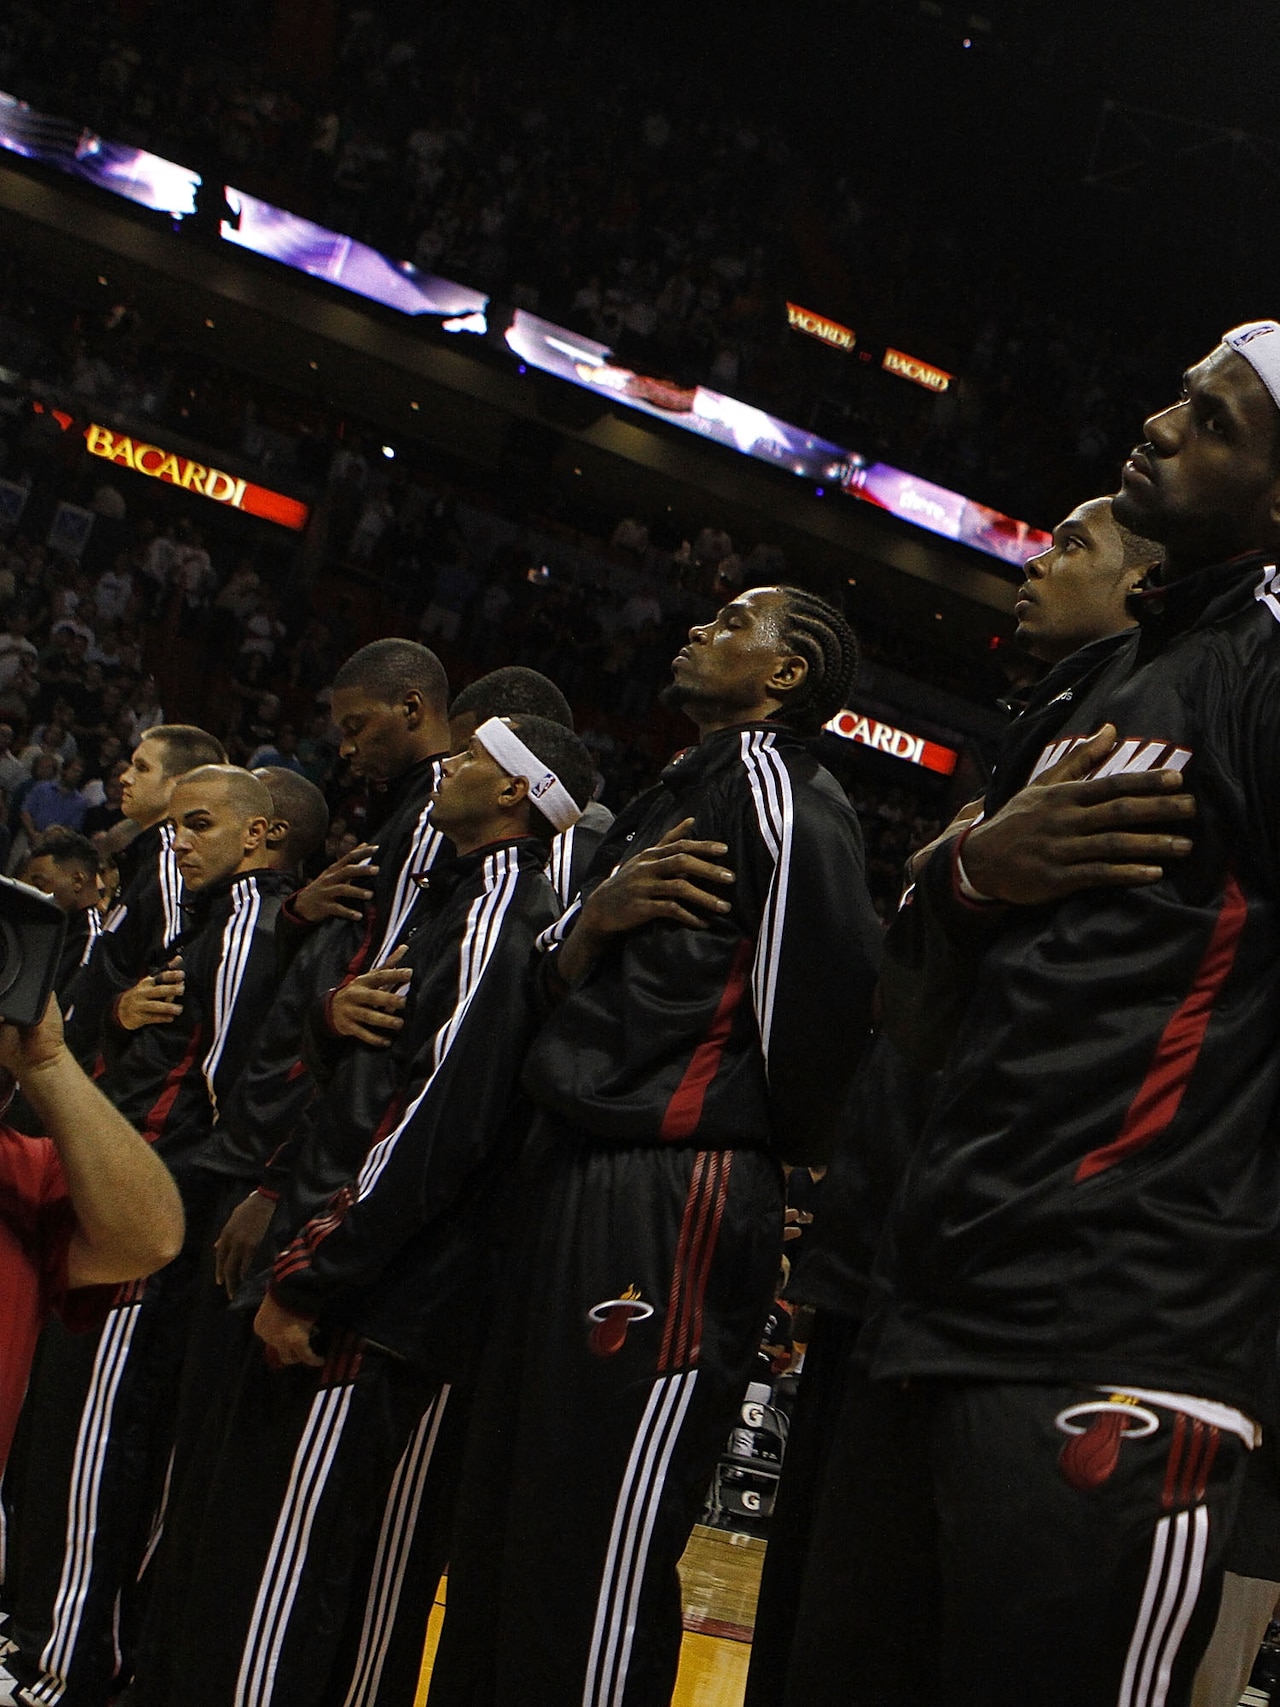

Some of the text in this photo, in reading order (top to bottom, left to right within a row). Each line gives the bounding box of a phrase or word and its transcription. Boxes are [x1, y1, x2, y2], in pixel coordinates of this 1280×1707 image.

[87, 422, 247, 511] BACARDI
[825, 708, 925, 766] CARDI
[741, 1402, 764, 1428] G
[741, 1490, 761, 1511] G
